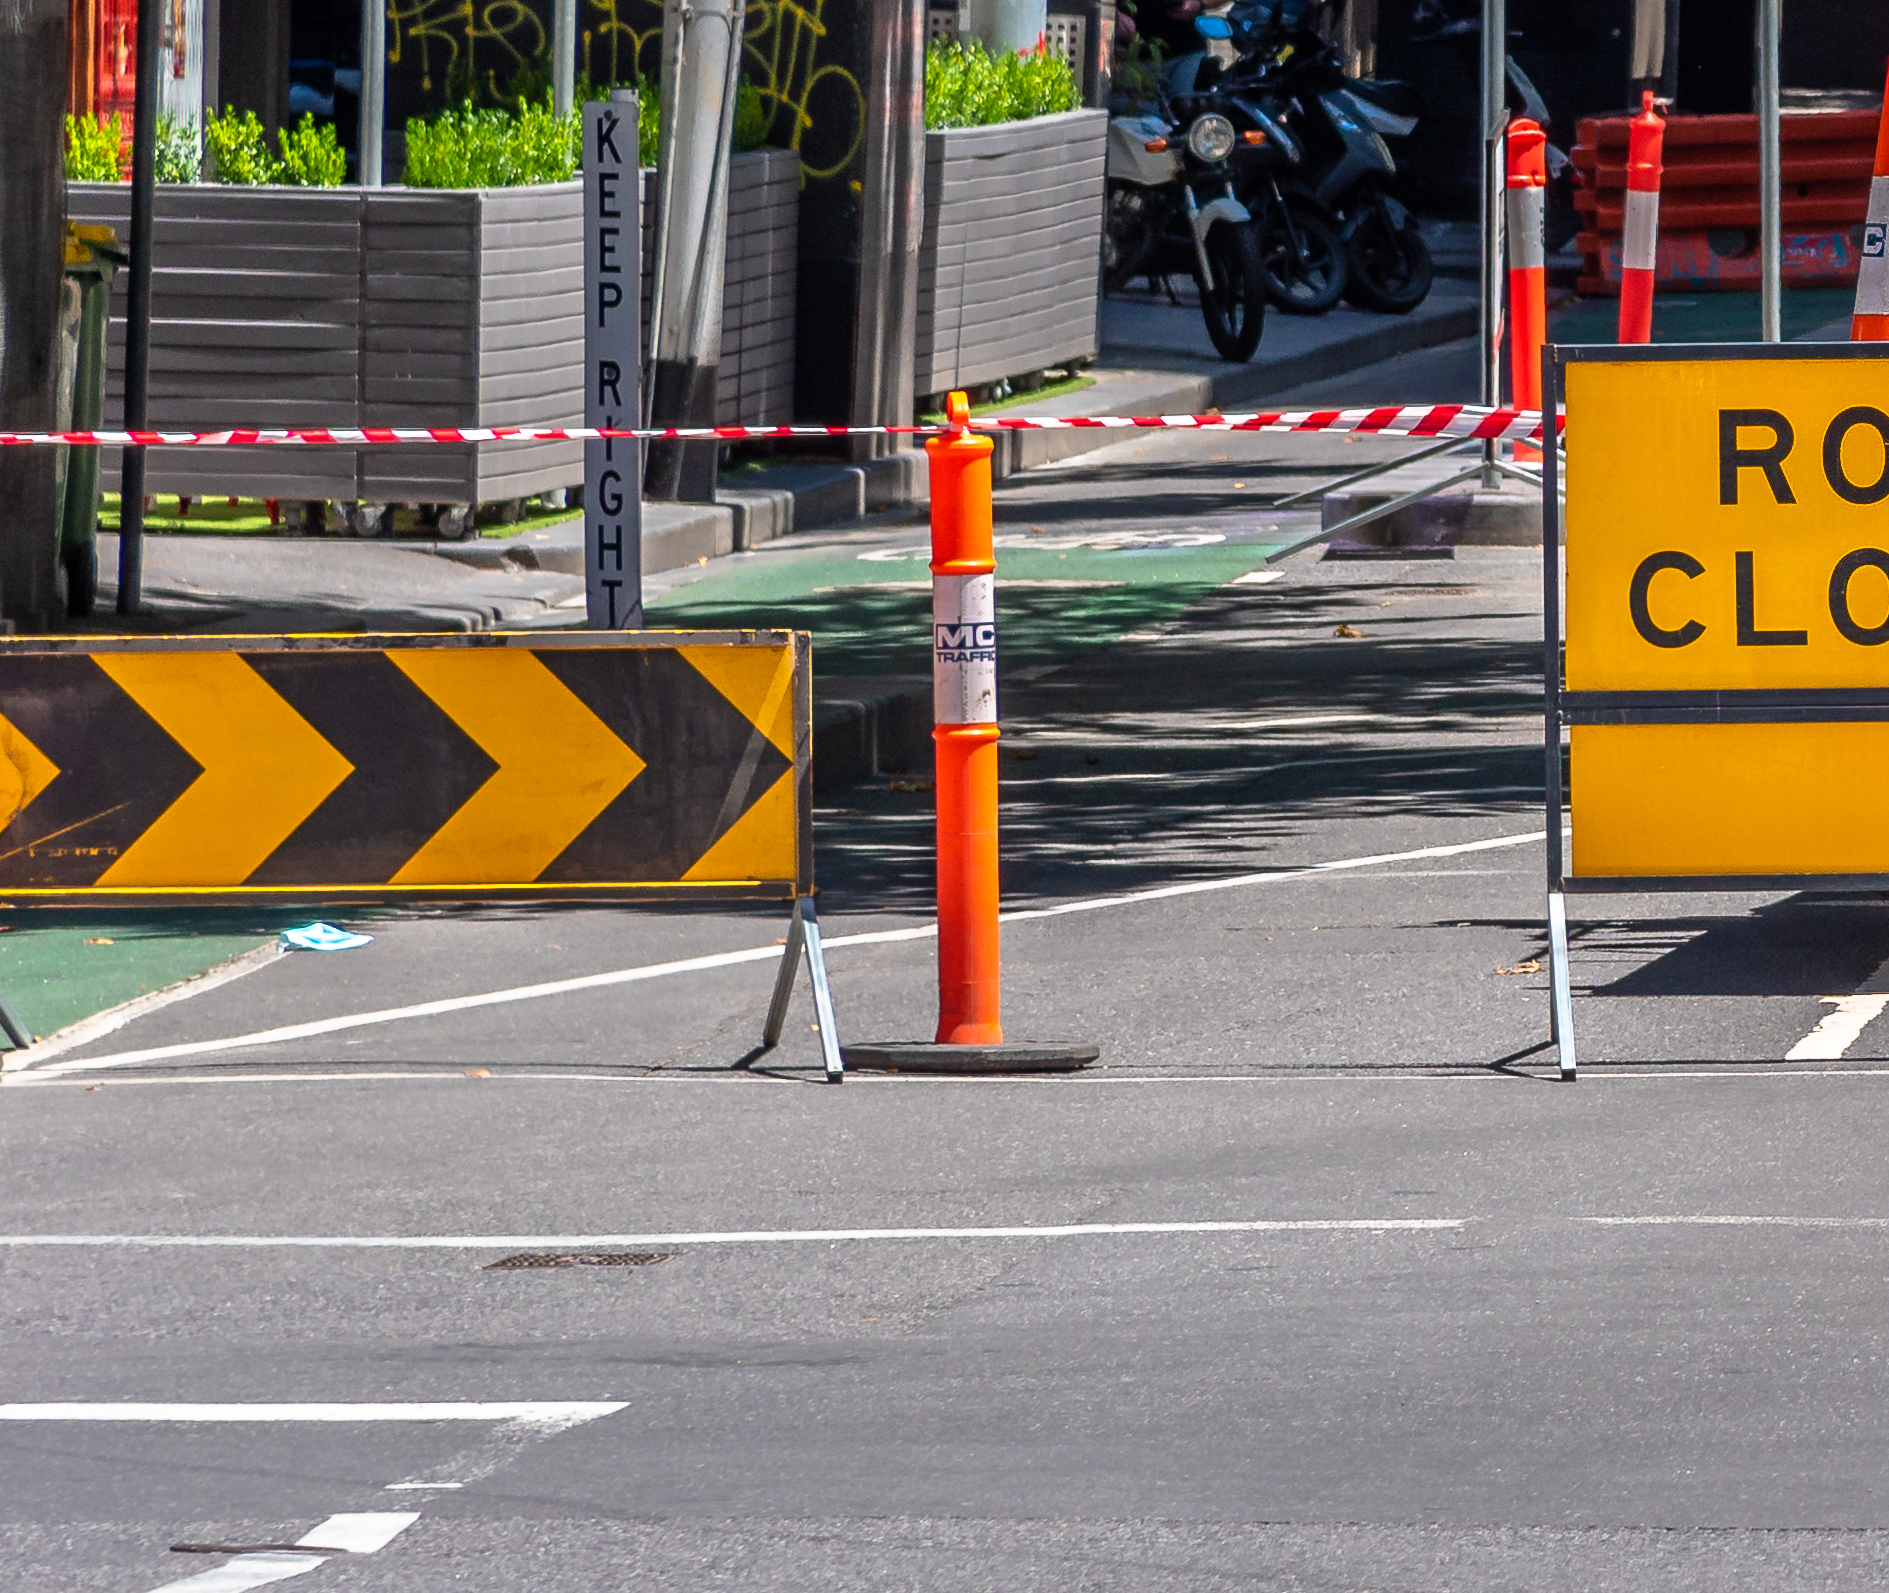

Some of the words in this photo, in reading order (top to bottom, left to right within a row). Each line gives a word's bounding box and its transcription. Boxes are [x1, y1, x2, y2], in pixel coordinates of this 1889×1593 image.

[597, 116, 625, 329] KEEP
[597, 369, 625, 629] RIGHT
[936, 624, 995, 648] MC
